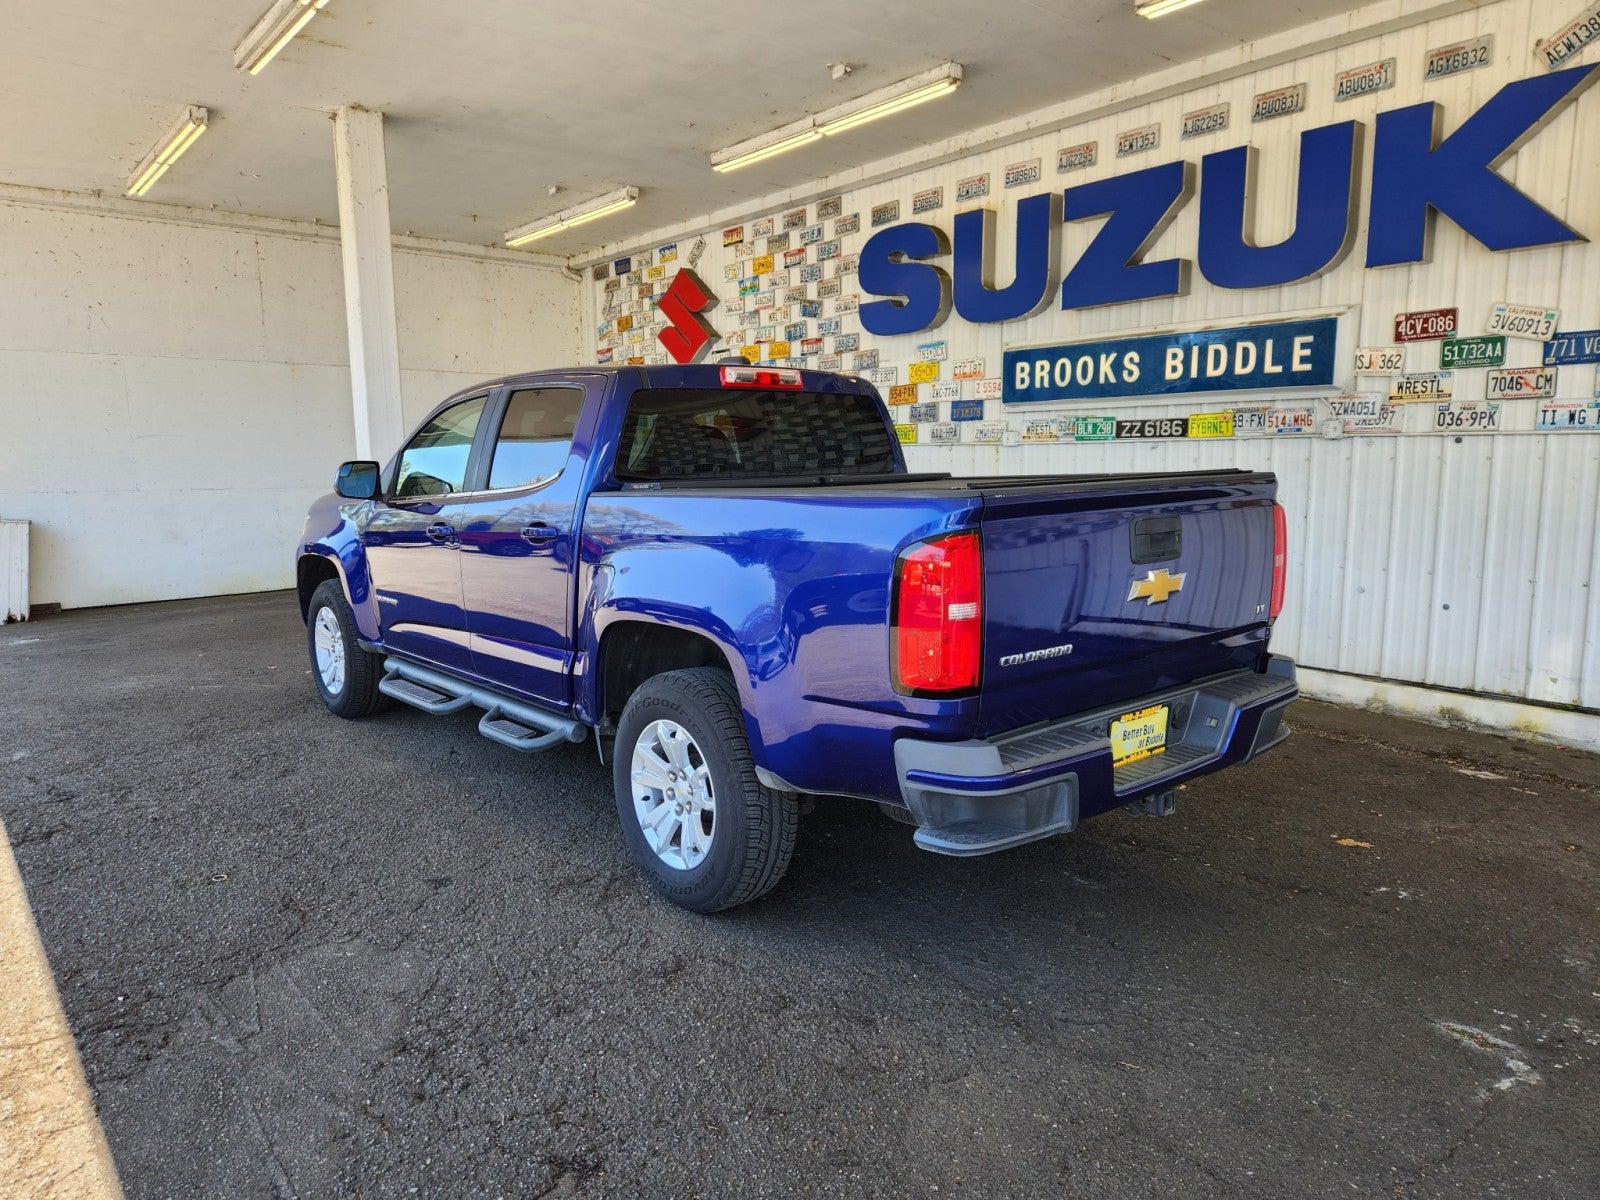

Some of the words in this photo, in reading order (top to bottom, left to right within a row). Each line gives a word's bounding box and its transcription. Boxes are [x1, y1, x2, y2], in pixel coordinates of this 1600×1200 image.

[1427, 46, 1488, 76] AGY6832
[1338, 69, 1387, 96] ABU0831
[1254, 93, 1299, 118] ABU0831
[1508, 307, 1543, 316] CALIFORNIA
[1398, 315, 1454, 336] 4CV-086
[1491, 314, 1551, 335] 3V60913
[1444, 342, 1502, 360] 51732AA
[1549, 338, 1576, 357] 771
[1015, 351, 1141, 390] BROOKS
[1164, 335, 1315, 381] BIDDLE
[1380, 353, 1402, 369] 362
[1454, 358, 1490, 366] COLORADO
[983, 381, 1001, 393] 5594
[1397, 379, 1444, 394] WRESTL
[1492, 376, 1523, 392] 7046
[1536, 374, 1553, 390] CM
[1268, 414, 1286, 428] 514
[1293, 413, 1313, 427] MHG
[1437, 411, 1464, 427] 036
[1541, 409, 1557, 425] TI
[1568, 409, 1587, 425] WG
[1026, 424, 1052, 435] WRESTL
[1121, 422, 1141, 437] ZZ
[1144, 420, 1183, 437] 6186
[1190, 420, 1230, 435] FYBRNET
[999, 644, 1073, 667] COLORADO
[1123, 727, 1142, 741] Better
[1144, 724, 1155, 736] Buy
